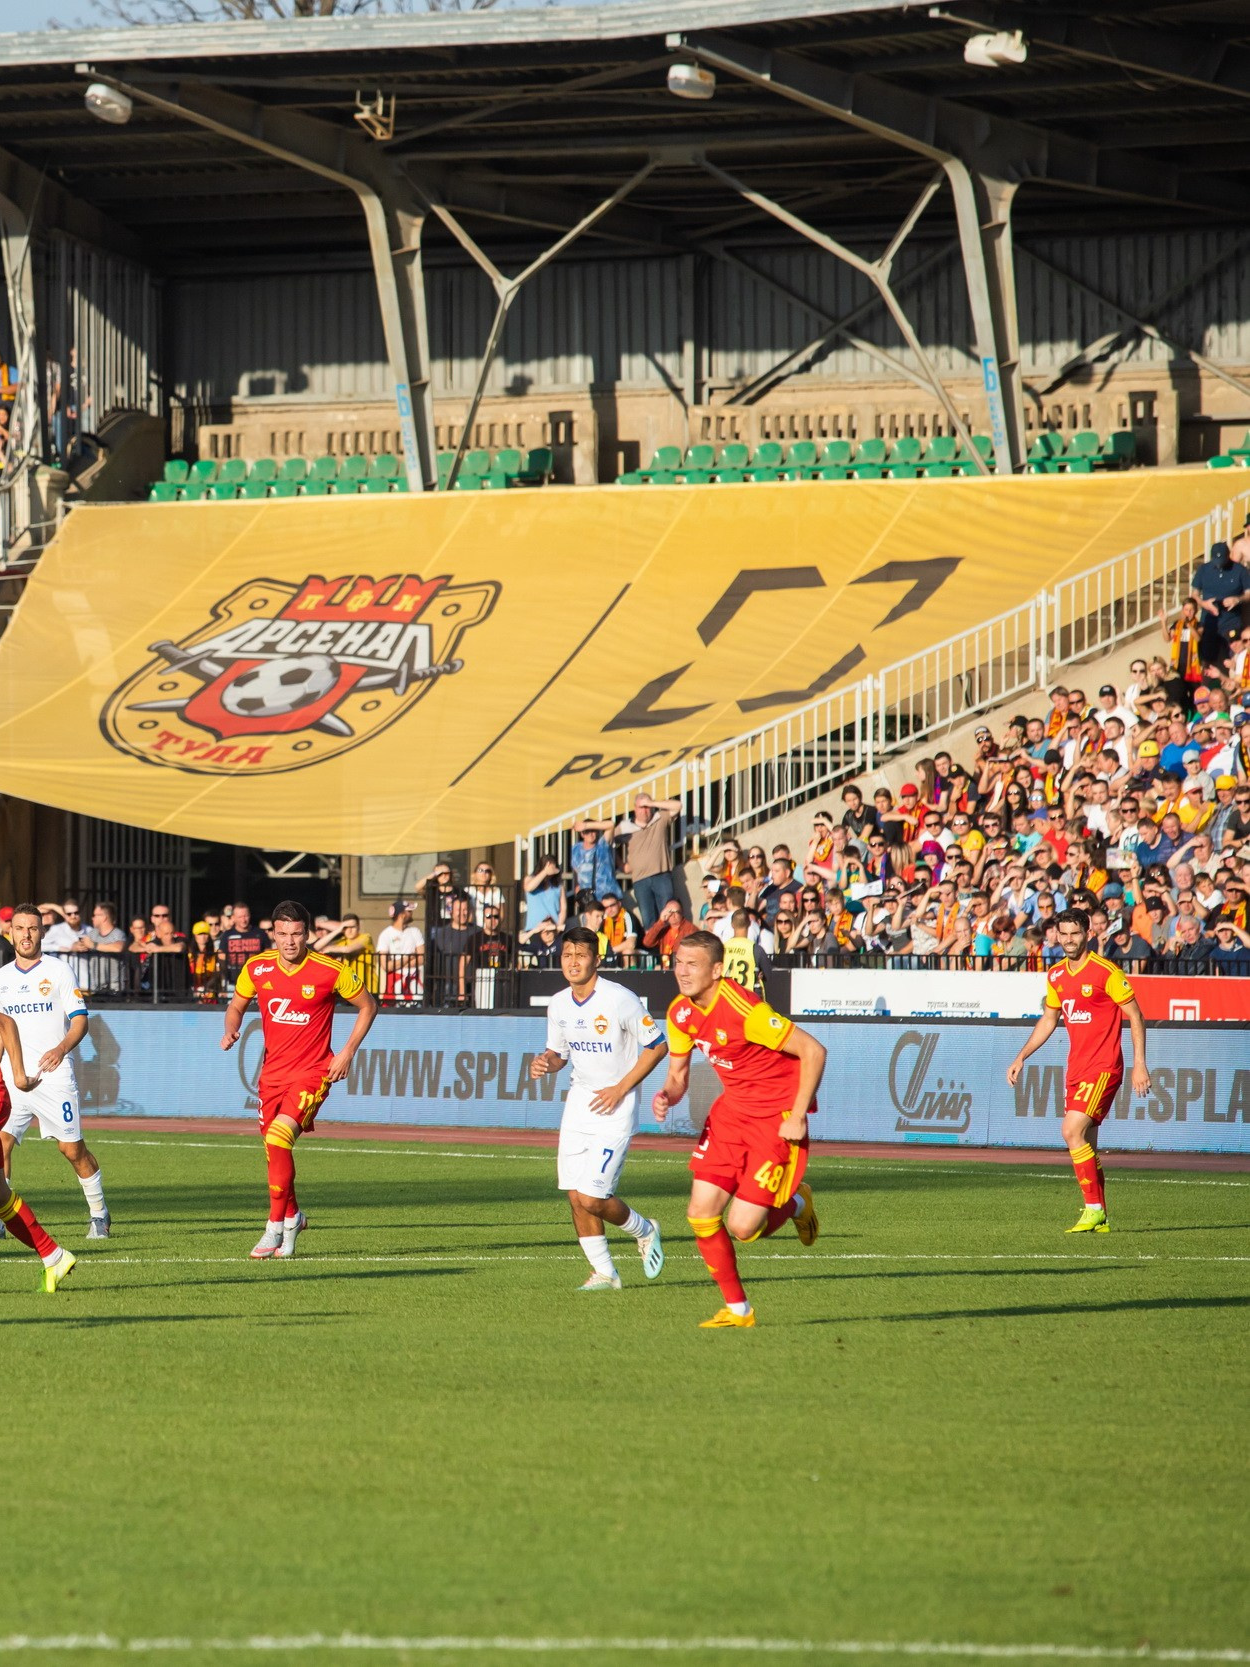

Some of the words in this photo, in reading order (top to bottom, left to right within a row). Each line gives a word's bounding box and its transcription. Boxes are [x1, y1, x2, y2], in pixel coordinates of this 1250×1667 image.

[189, 618, 434, 673] АРСЕНАЛ
[150, 730, 272, 765] ТУЛА
[8, 1002, 53, 1014] РОССЕТИ
[569, 1041, 612, 1053] РОССЕТИ
[297, 1090, 314, 1111] 11
[1073, 1081, 1094, 1102] 21
[61, 1101, 74, 1123] 8
[602, 1148, 613, 1174] 7
[753, 1160, 784, 1193] 48
